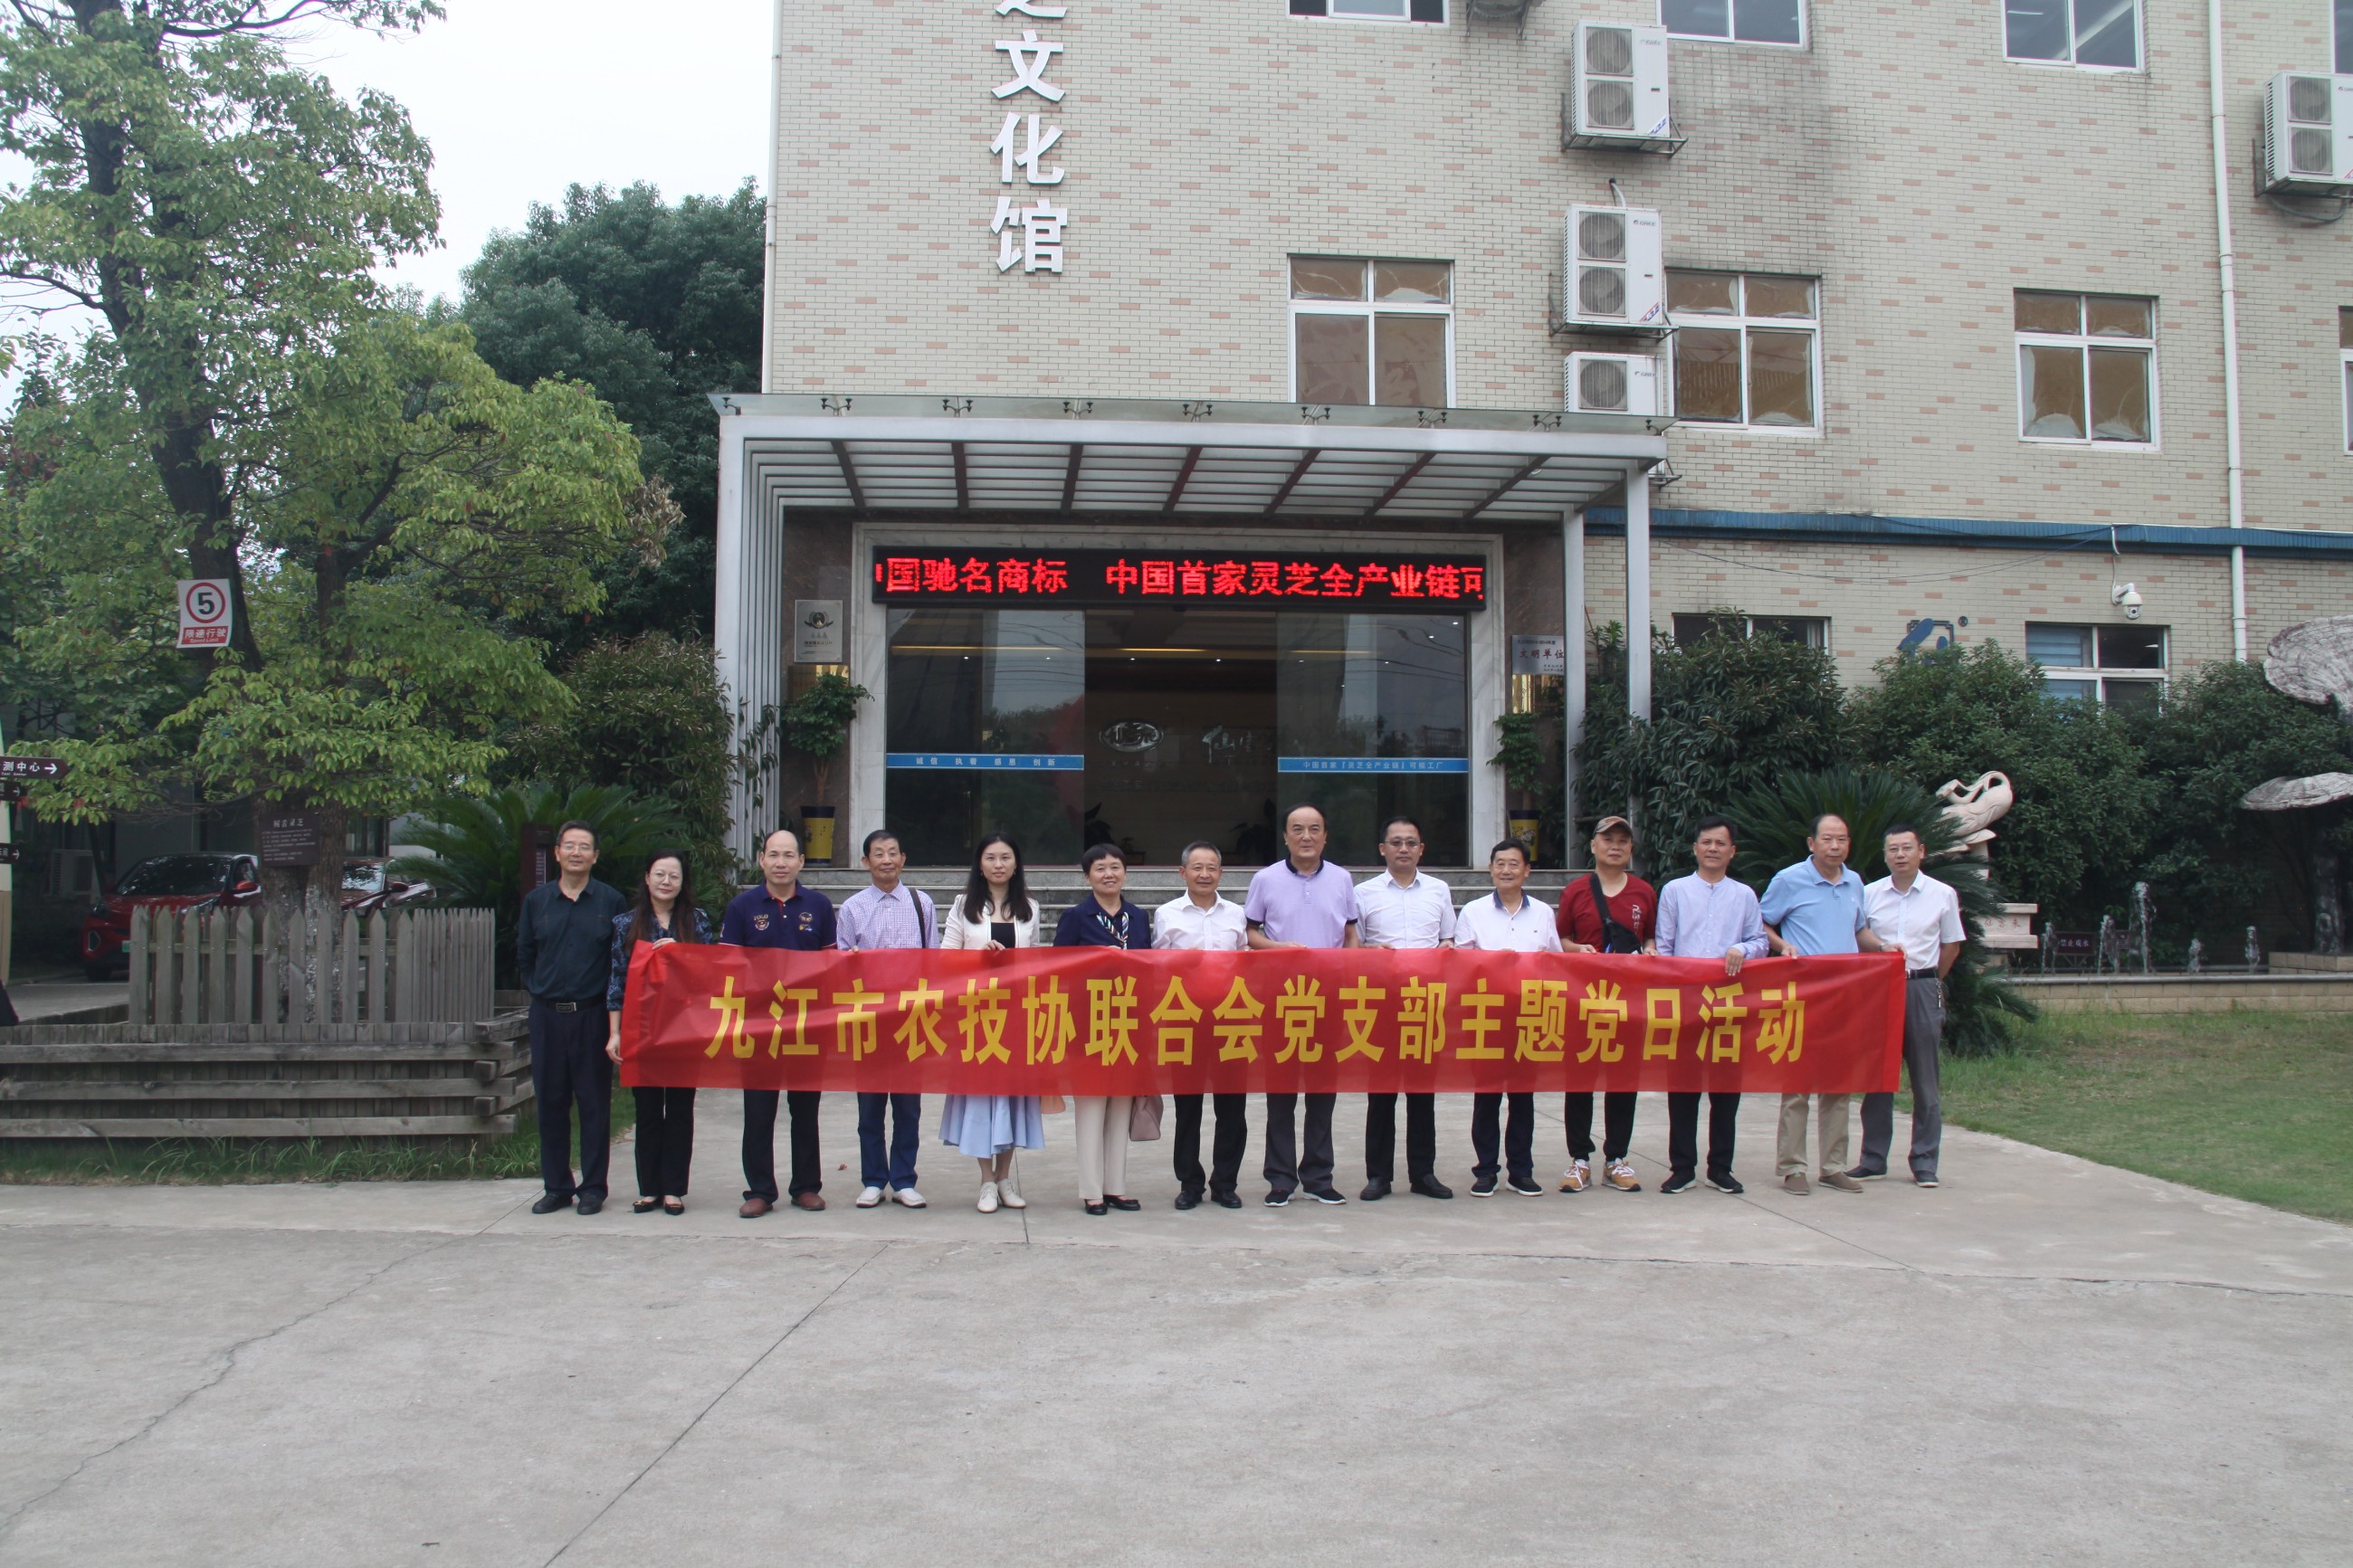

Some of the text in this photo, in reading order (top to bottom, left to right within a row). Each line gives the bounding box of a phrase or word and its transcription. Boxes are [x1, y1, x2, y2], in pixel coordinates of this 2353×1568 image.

[875, 557, 1068, 594] 国驰名商标
[197, 592, 215, 615] 5
[185, 628, 226, 639] 限速行驶
[1519, 648, 1565, 660] 文明单位
[916, 756, 938, 765] 诚信
[994, 757, 1016, 766] 感恩
[1033, 757, 1055, 766] 创新
[704, 976, 1806, 1065] 九江市农技协联合会党支部主题党日活动
